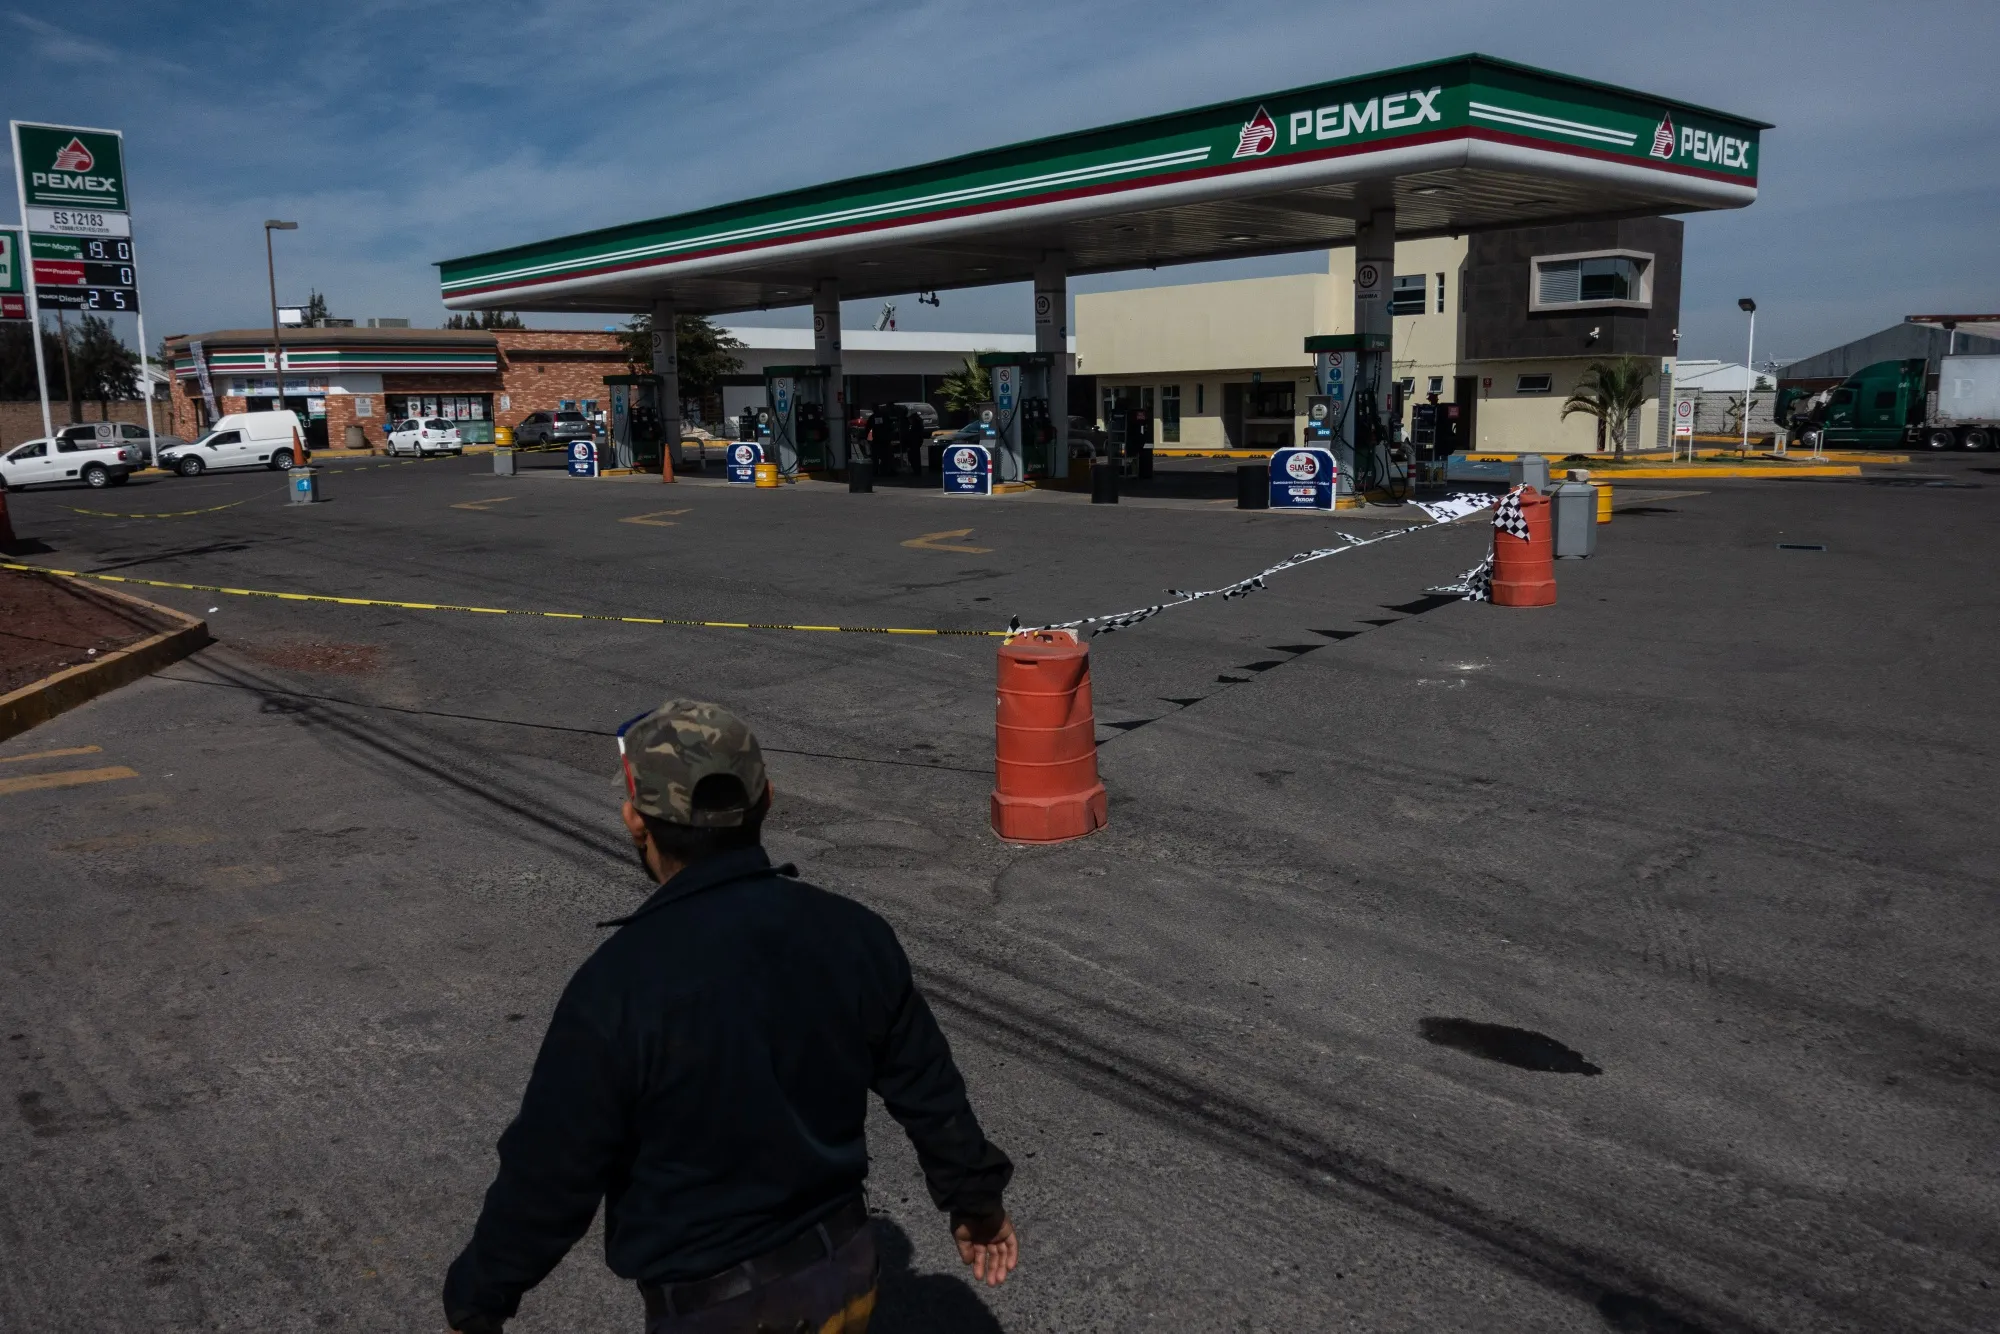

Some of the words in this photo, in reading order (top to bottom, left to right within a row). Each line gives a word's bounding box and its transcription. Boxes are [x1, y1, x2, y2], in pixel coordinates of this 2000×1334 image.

[1290, 86, 1441, 145] PEMEX
[1680, 126, 1750, 169] PEMEX
[32, 172, 117, 192] PEMEX
[53, 212, 68, 224] ES
[71, 213, 103, 226] 12183
[52, 243, 77, 252] Magna
[53, 267, 81, 275] Premium
[1362, 270, 1372, 280] 10
[58, 293, 84, 303] Diesel
[1289, 464, 1314, 472] SUMEC
